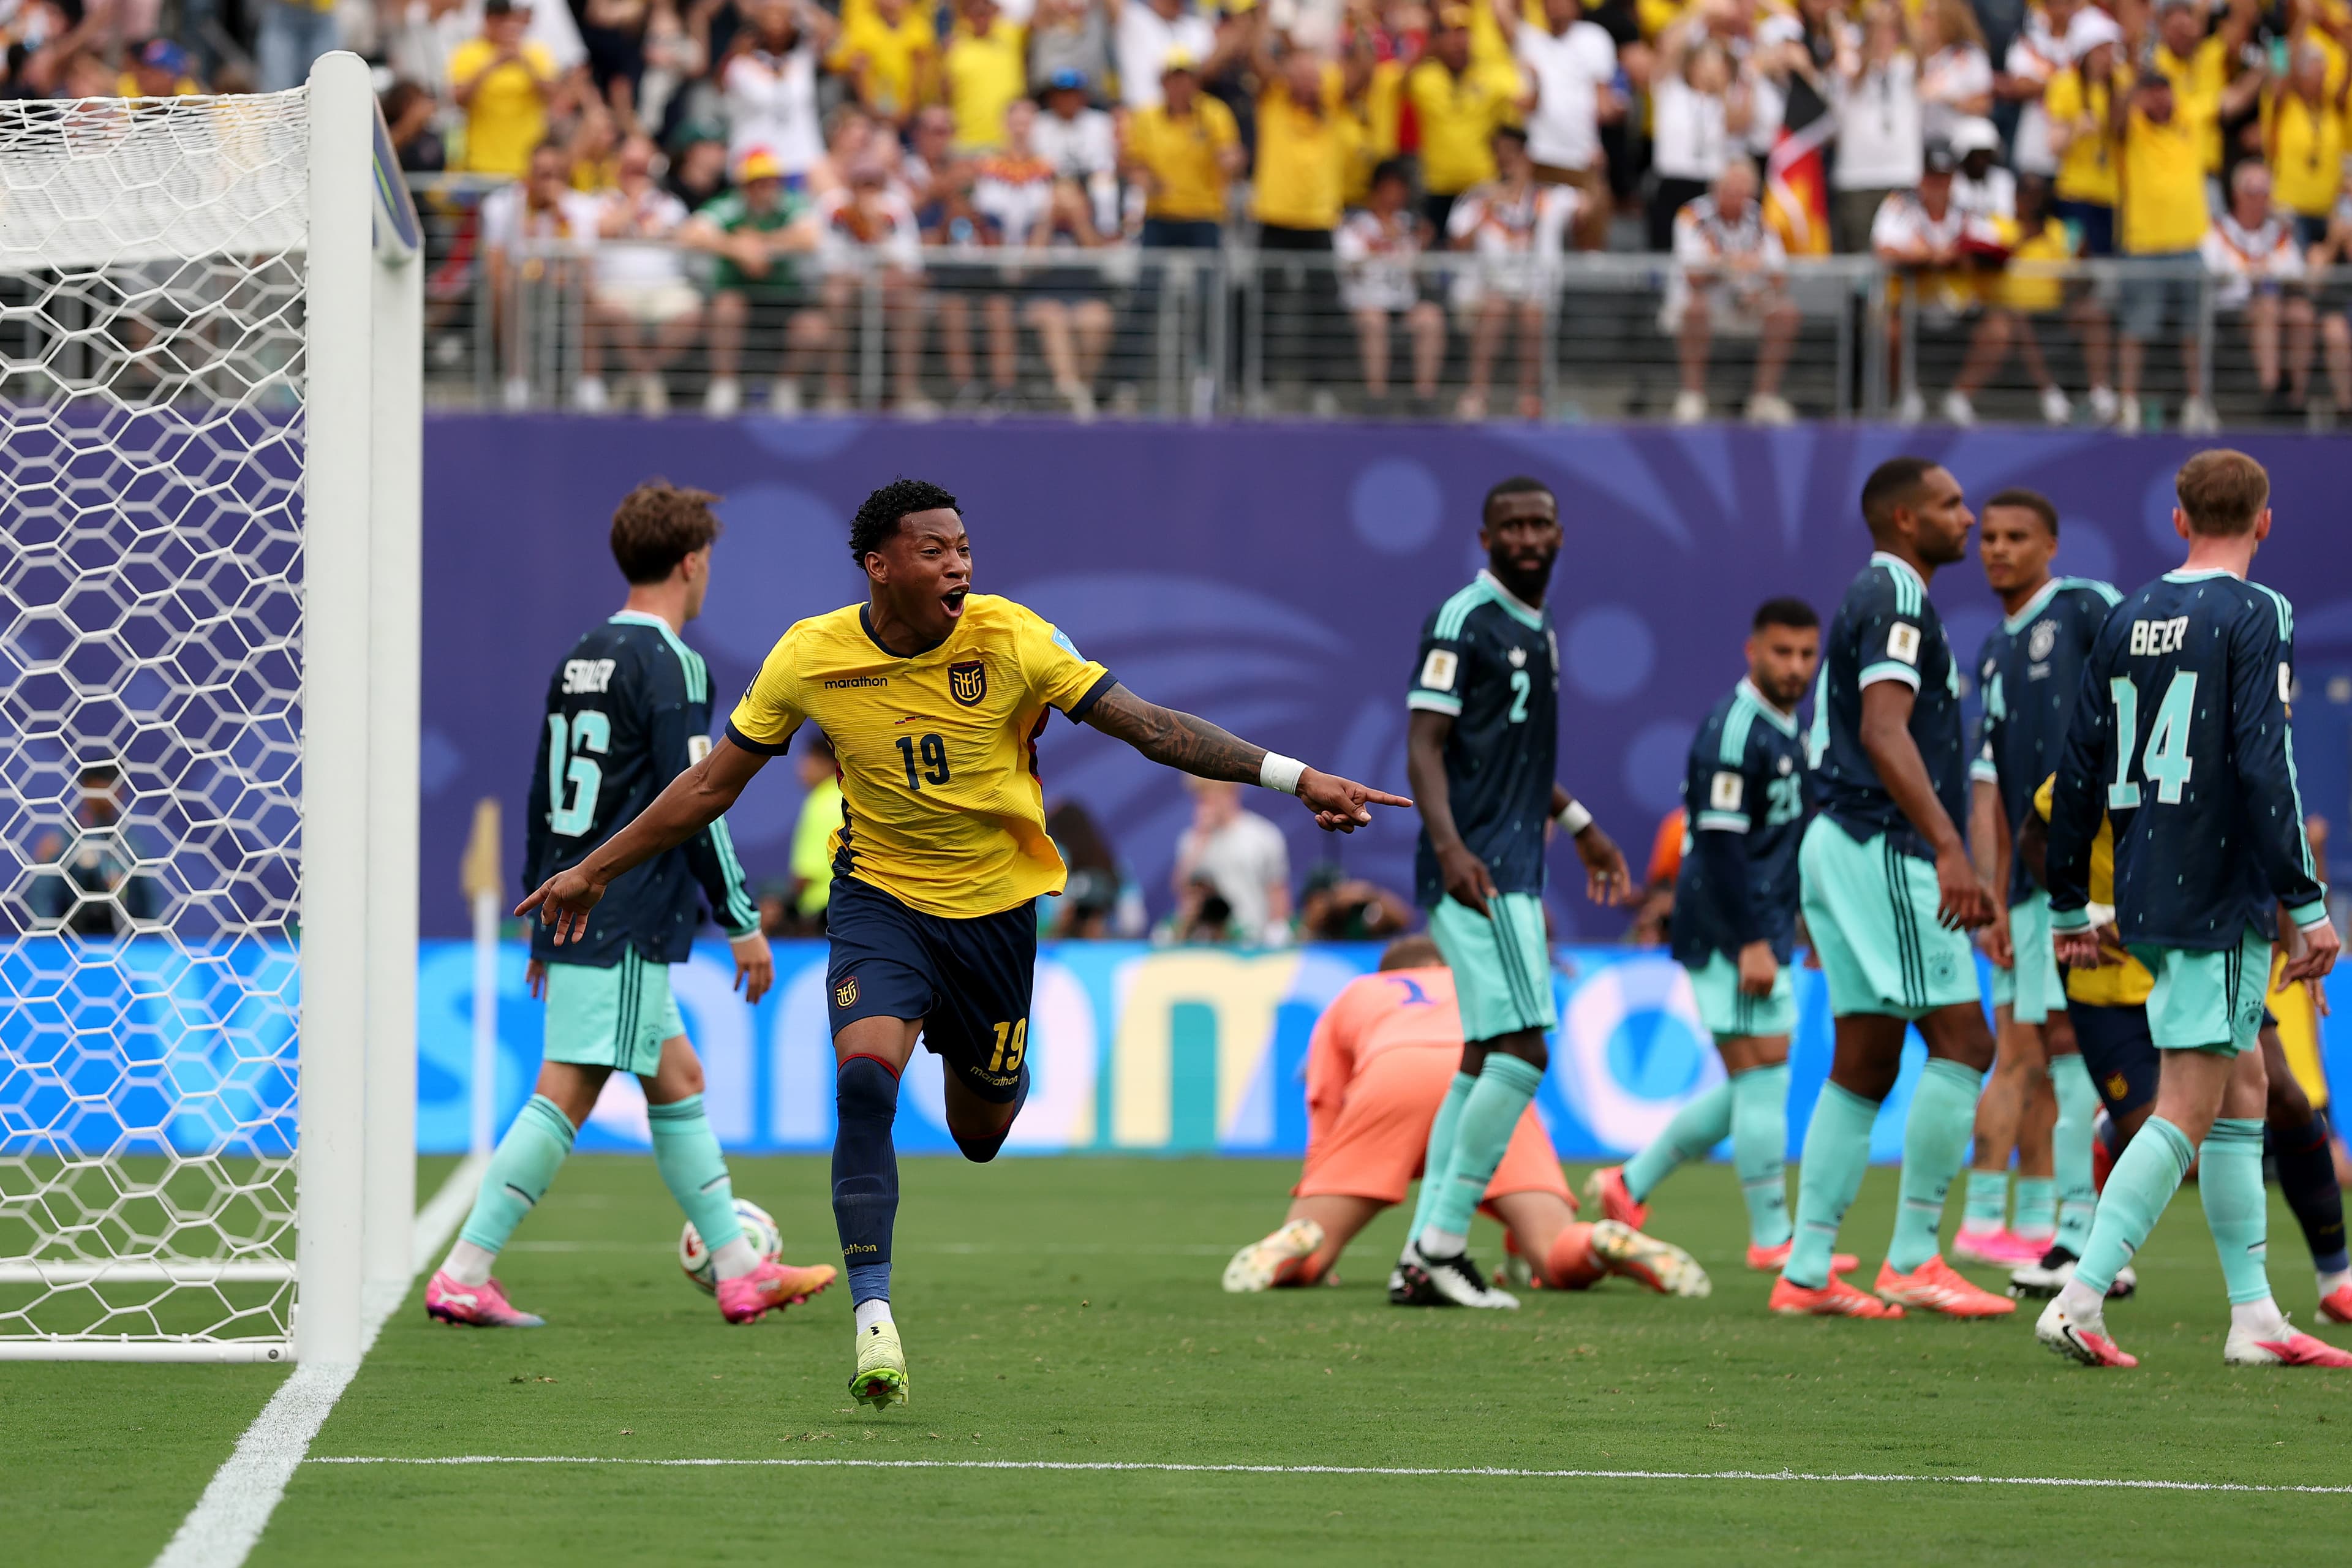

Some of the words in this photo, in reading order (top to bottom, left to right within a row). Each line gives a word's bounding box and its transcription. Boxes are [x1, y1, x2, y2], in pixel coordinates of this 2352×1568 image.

[824, 676, 888, 689] marathon
[1509, 669, 1530, 723] 2
[895, 734, 950, 790] 19
[2108, 670, 2198, 810] 14
[548, 709, 611, 837] 16
[989, 1017, 1027, 1072] 19
[970, 1066, 1018, 1086] marathon
[842, 1243, 878, 1257] athon
